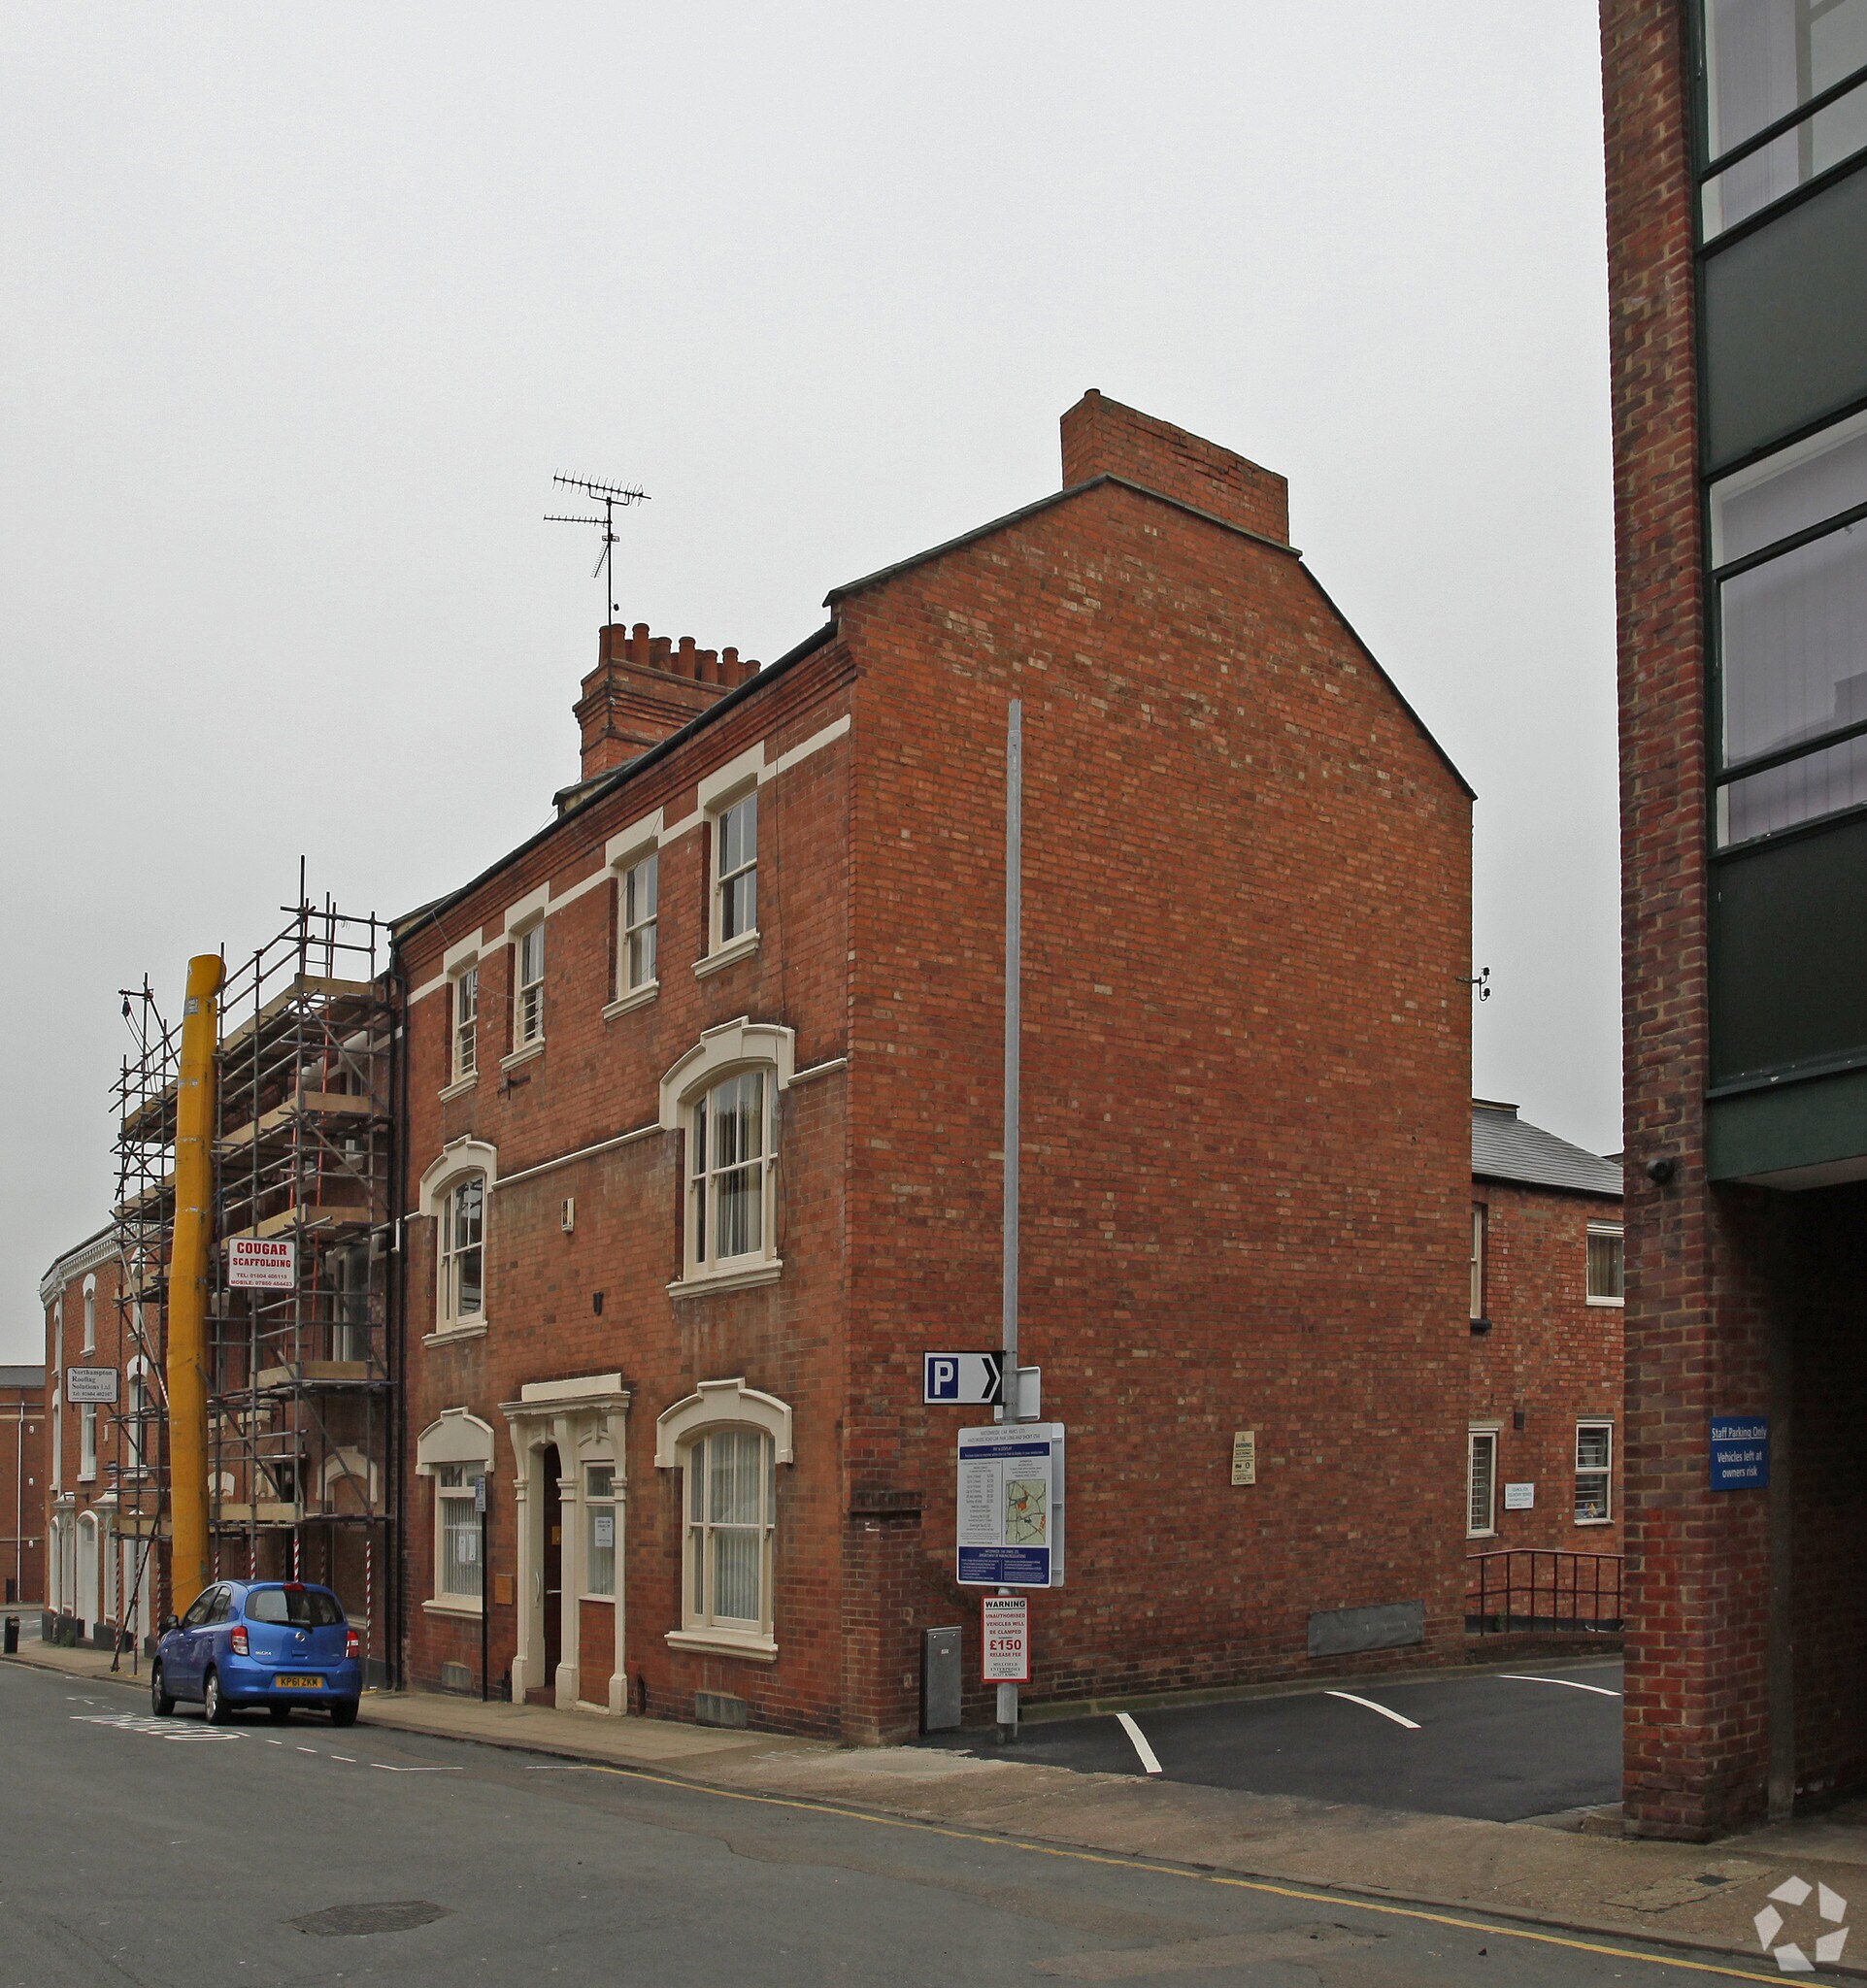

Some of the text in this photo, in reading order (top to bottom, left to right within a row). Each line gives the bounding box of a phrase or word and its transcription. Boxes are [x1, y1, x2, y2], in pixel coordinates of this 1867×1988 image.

[237, 1242, 287, 1255] COUGAR
[233, 1258, 291, 1268] SCAFFOLDING
[934, 1361, 953, 1395] P
[1712, 1426, 1767, 1439] Staff Parking Only
[1717, 1450, 1762, 1463] Vehicles left at
[1722, 1465, 1758, 1478] owners risk
[990, 1640, 1022, 1650] £150
[281, 1677, 300, 1686] KP61
